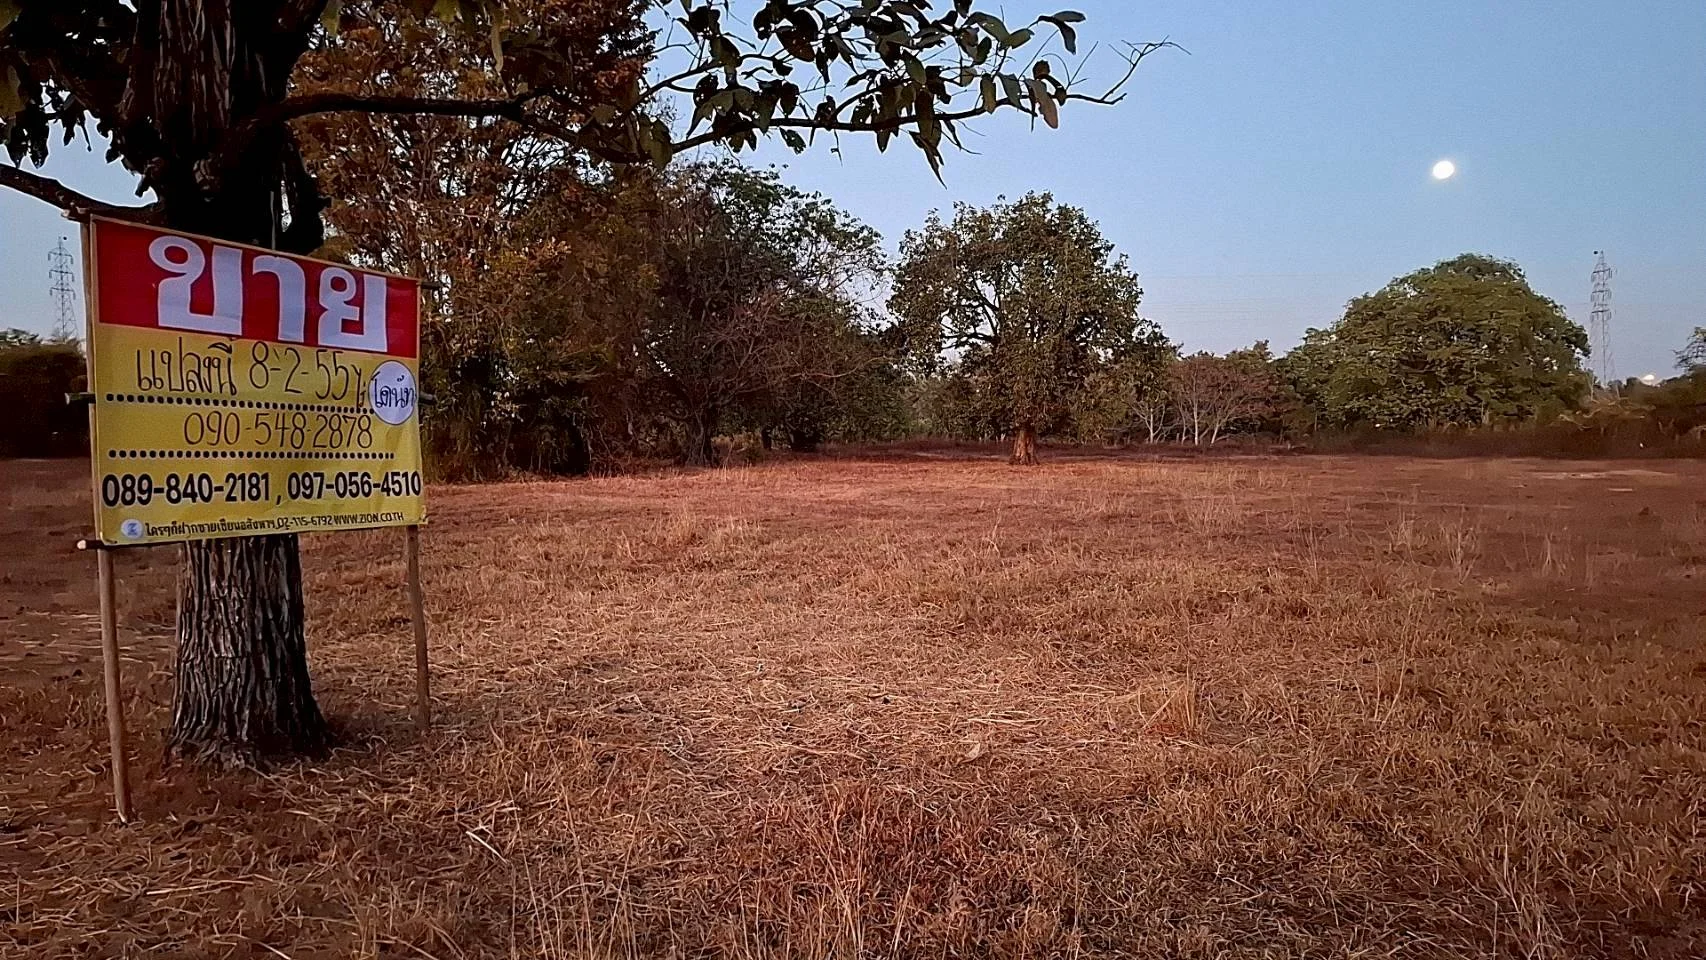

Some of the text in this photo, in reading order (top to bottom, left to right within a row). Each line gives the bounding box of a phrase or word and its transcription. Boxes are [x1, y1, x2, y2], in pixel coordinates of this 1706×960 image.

[148, 235, 388, 353] ขาย
[183, 410, 373, 449] 090-548-2878
[287, 470, 422, 499] 097-056-4510
